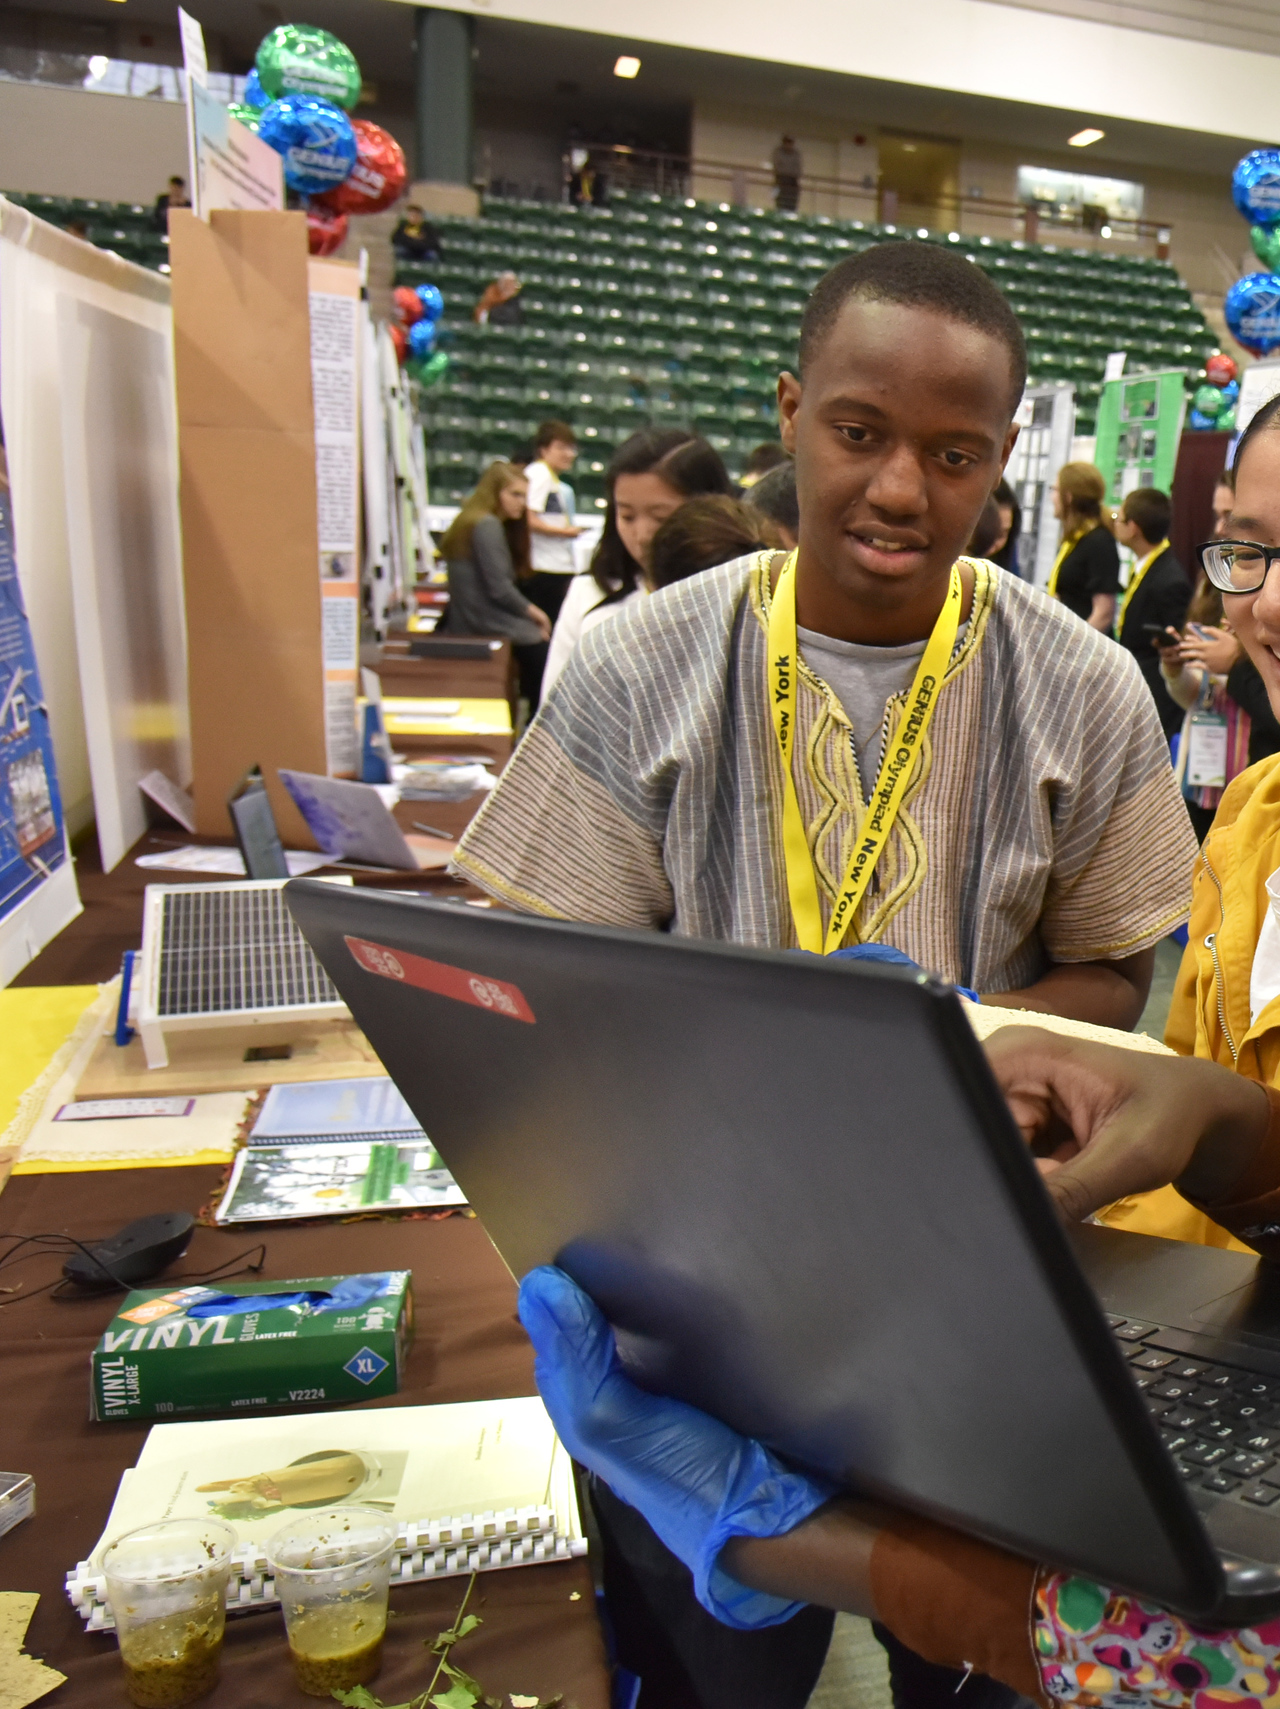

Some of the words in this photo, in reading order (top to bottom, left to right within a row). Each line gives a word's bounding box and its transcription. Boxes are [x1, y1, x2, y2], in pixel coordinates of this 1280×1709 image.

[775, 655, 790, 703] York
[902, 675, 936, 746] GENIUS
[779, 710, 790, 755] ew
[870, 747, 911, 833] Olympiad
[850, 838, 878, 883] New
[832, 891, 857, 934] York
[104, 1316, 235, 1353] VINYL
[239, 1313, 260, 1342] GLOVES
[255, 1332, 277, 1341] LATEX
[278, 1331, 298, 1339] FREE
[101, 1356, 126, 1409] VINYL
[125, 1364, 141, 1405] X-LARGE
[357, 1358, 376, 1374] XL
[105, 1408, 129, 1416] GLOVES
[155, 1402, 174, 1413] 100
[251, 1397, 268, 1405] FREE
[289, 1388, 326, 1401] V2224
